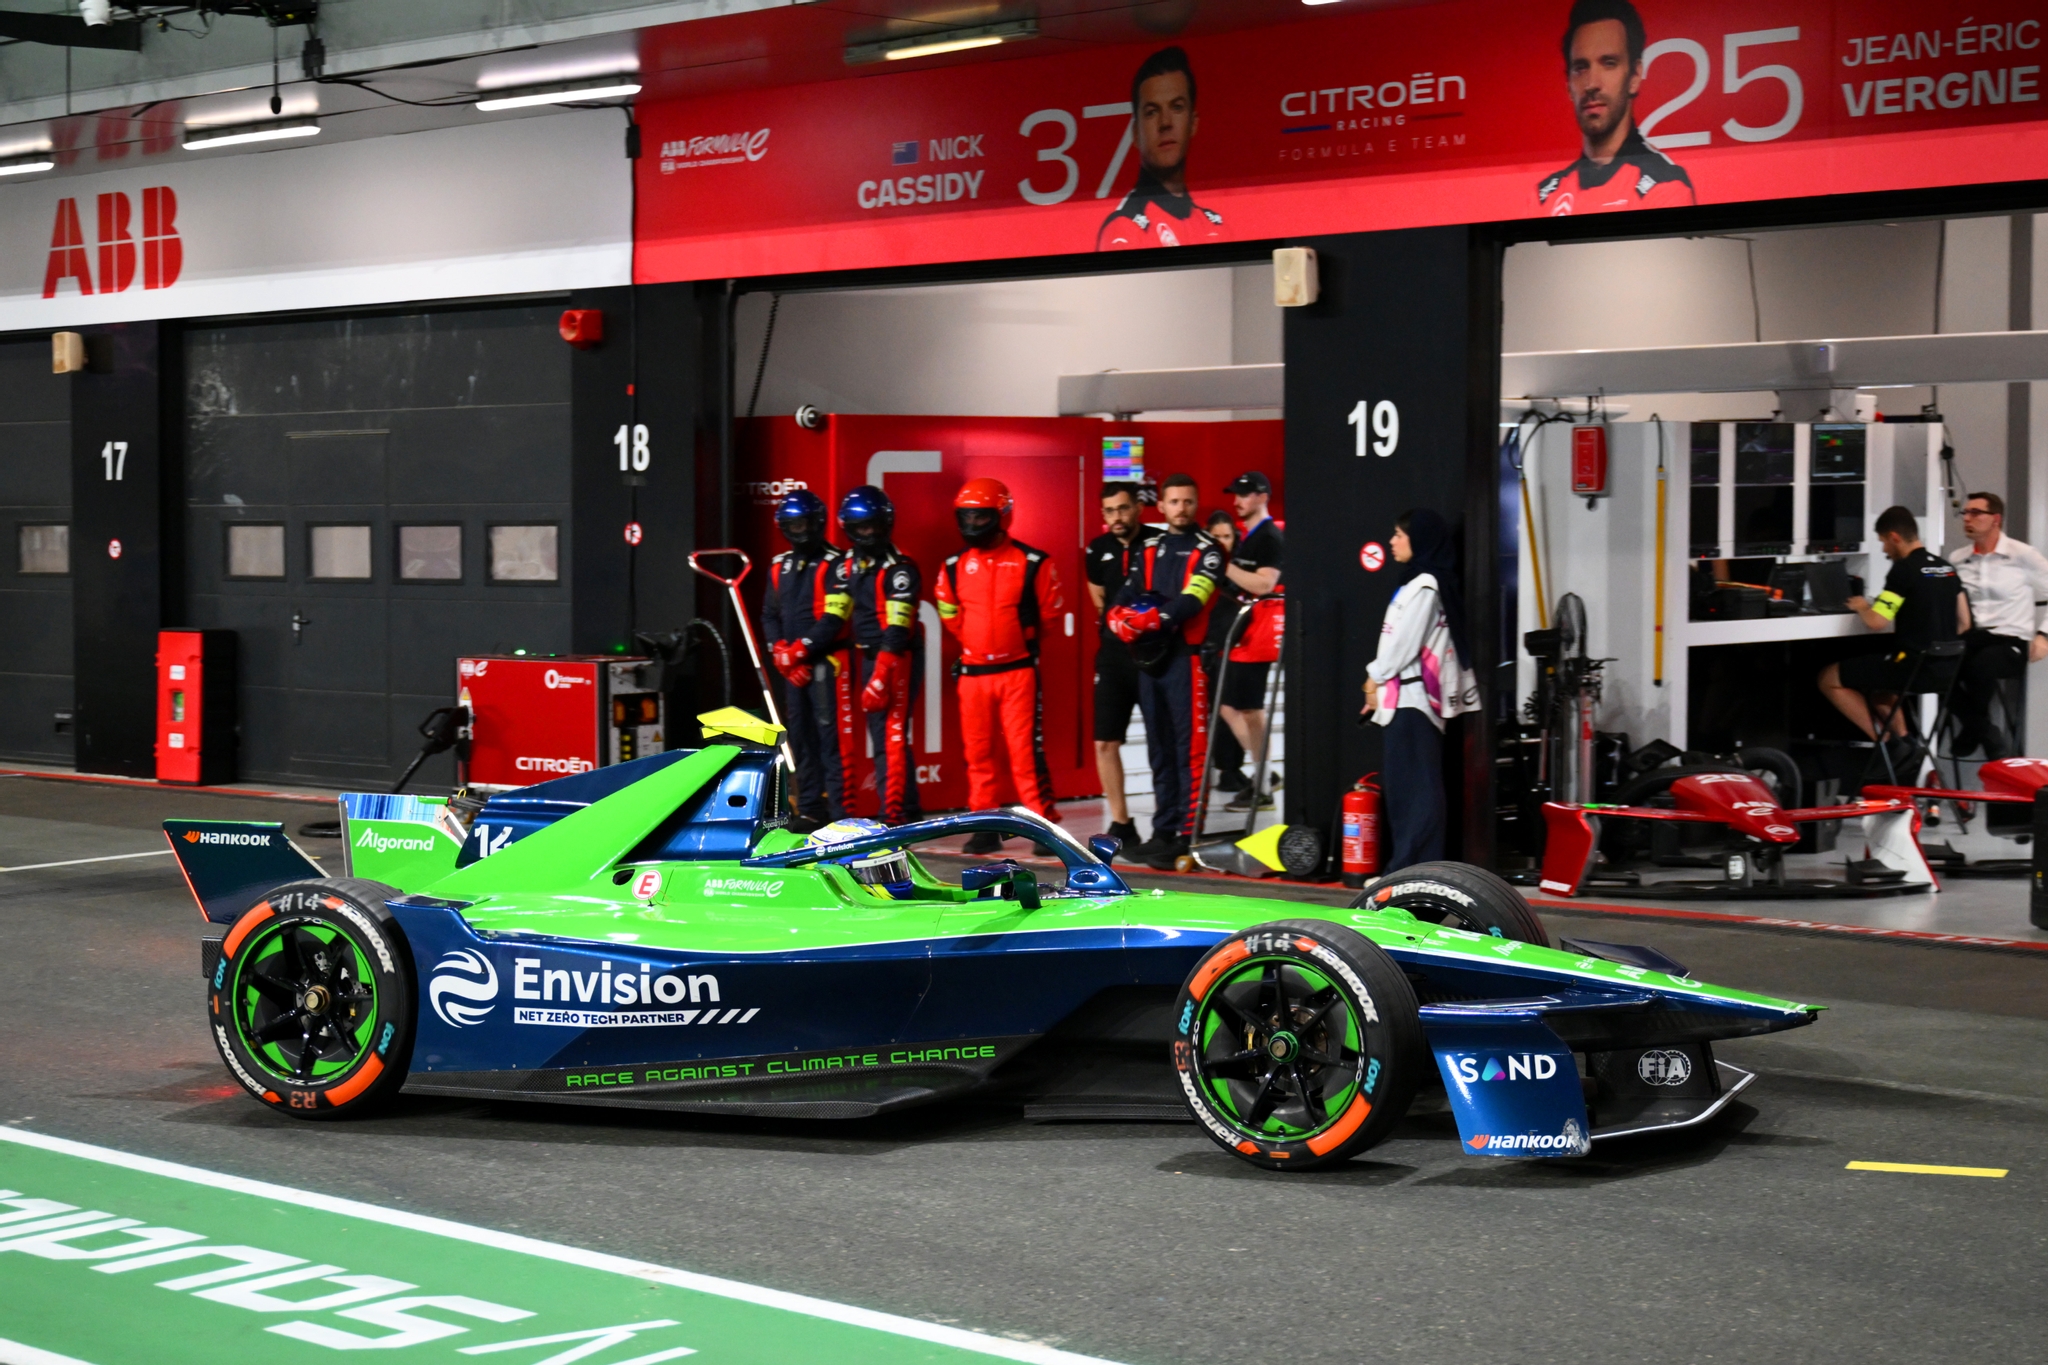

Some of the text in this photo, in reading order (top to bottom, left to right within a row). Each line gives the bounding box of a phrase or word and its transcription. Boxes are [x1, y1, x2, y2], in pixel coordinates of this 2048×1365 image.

[1841, 17, 2041, 67] JEAN-ÉRIC
[1638, 26, 1804, 150] 25
[1841, 65, 2041, 117] VERGNE
[1336, 114, 1406, 131] RACING
[929, 134, 985, 161] NICK
[1017, 101, 1134, 205] 37
[1278, 134, 1466, 161] FORMULA E TEAM
[857, 169, 985, 209] CASSIDY
[42, 186, 183, 299] ABB
[613, 424, 650, 471] 18
[1347, 400, 1399, 457] 19
[101, 441, 128, 481] 17
[355, 827, 435, 853] Algorand
[827, 843, 854, 853] Envision
[278, 892, 320, 913] #14
[639, 875, 655, 895] E
[723, 878, 769, 892] FORMULA
[1245, 932, 1291, 955] #14
[514, 957, 721, 1005] Envision
[518, 1010, 685, 1025] NET ZERO TECH PARTNER
[566, 1045, 996, 1087] RACE AGAINST CLIMATE CHANGE
